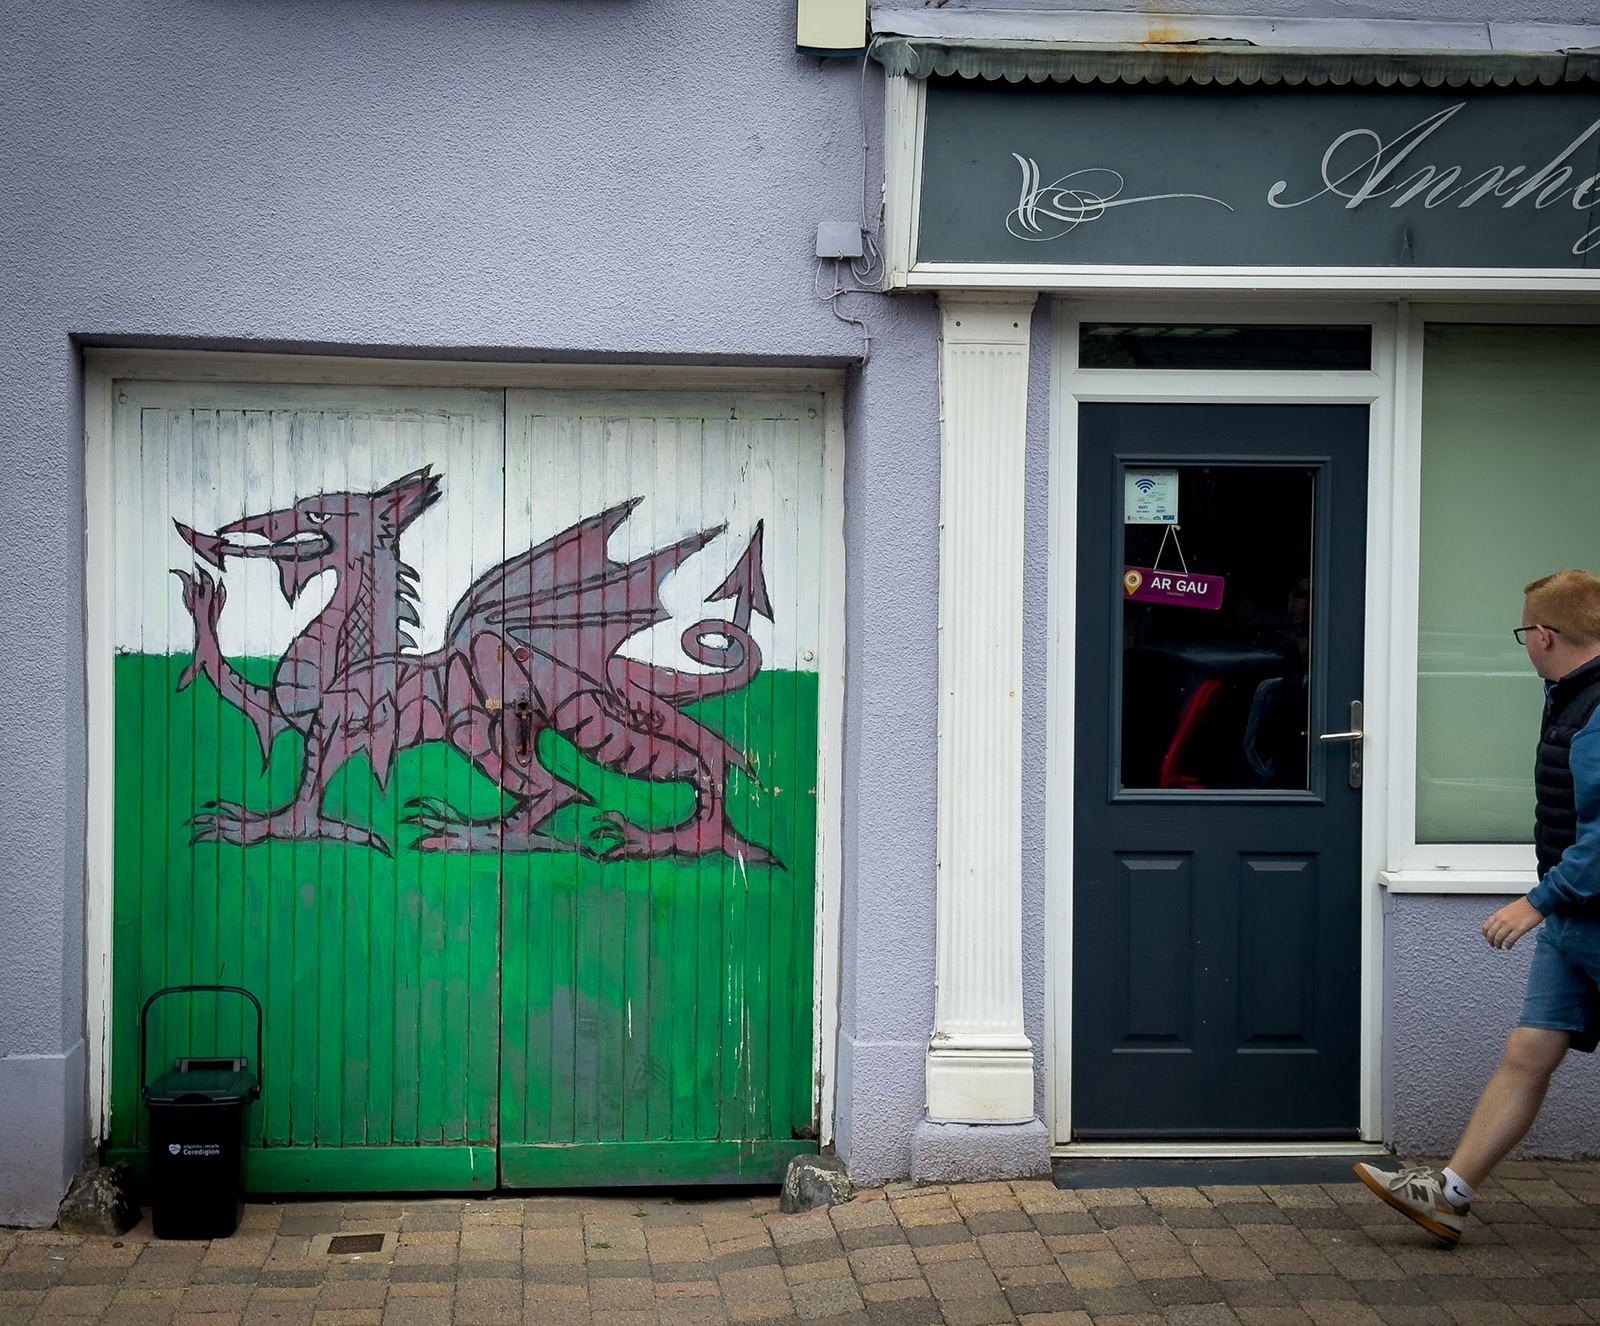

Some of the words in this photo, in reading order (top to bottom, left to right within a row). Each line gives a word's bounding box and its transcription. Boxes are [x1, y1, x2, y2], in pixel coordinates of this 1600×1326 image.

[1266, 101, 1600, 255] Anrhe
[1150, 577, 1171, 590] AR
[1176, 580, 1208, 594] GAU
